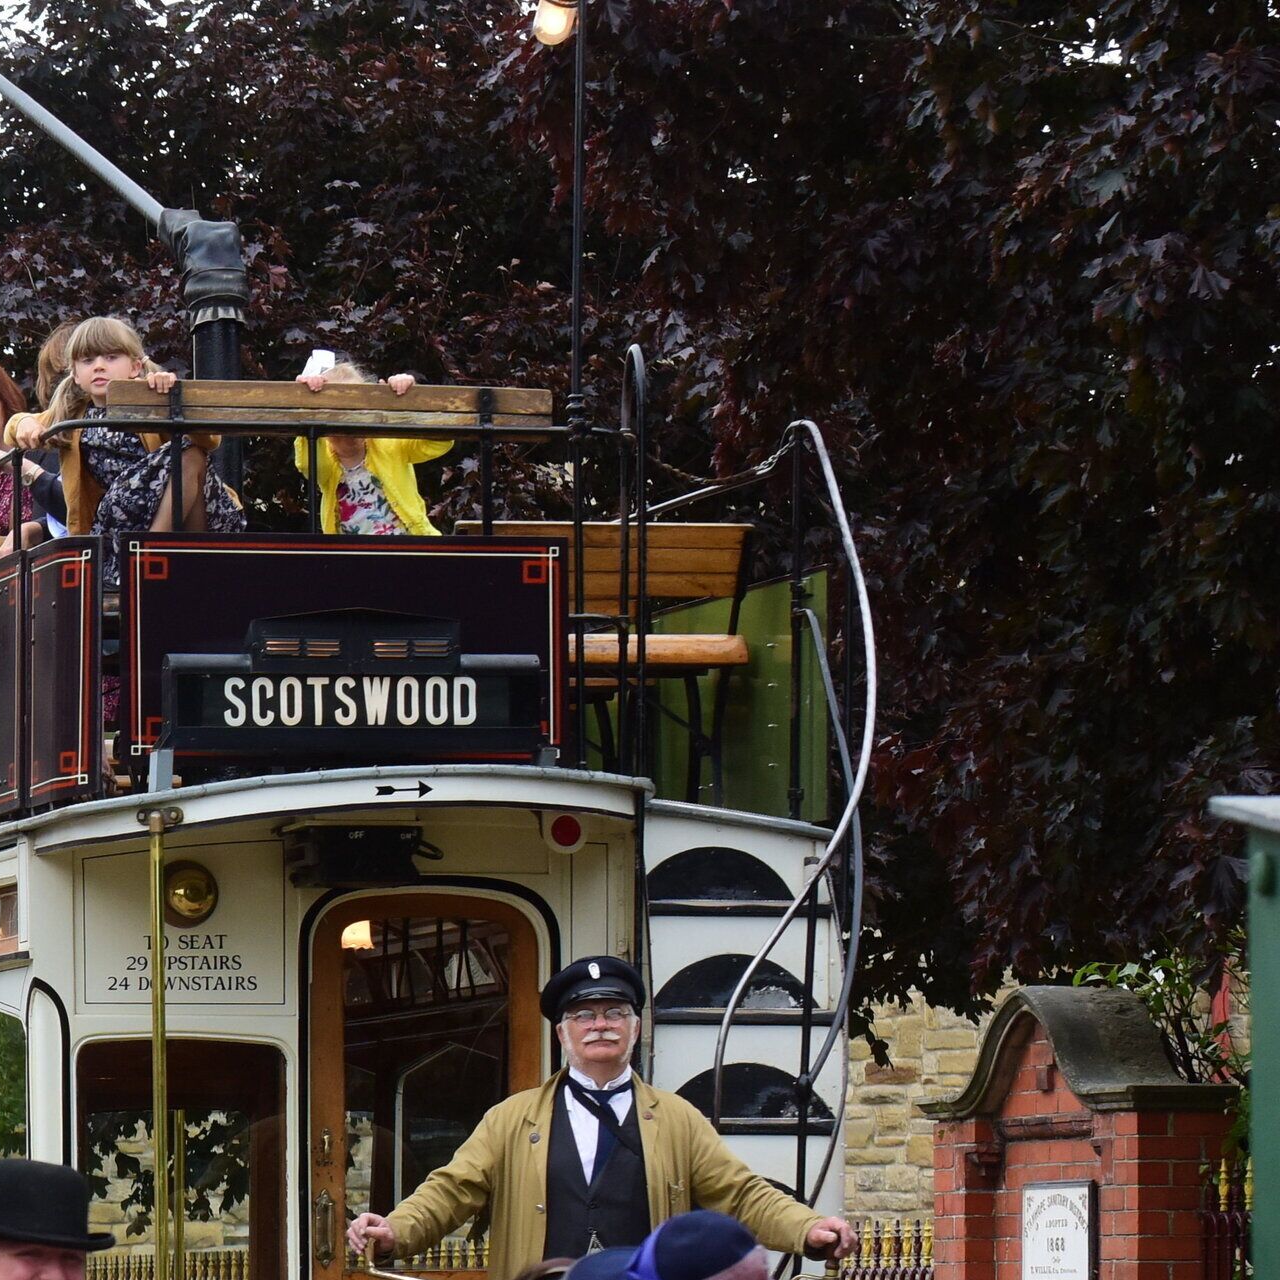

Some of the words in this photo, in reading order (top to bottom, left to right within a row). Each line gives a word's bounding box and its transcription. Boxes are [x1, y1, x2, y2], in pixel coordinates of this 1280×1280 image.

[223, 676, 477, 728] SCOTSWOOD
[348, 830, 365, 840] OFF
[178, 934, 228, 950] SEAT
[126, 956, 148, 971] 29
[161, 955, 242, 971] PSTAIRS
[108, 976, 130, 991] 24
[138, 976, 258, 991] DWNSTAIRS
